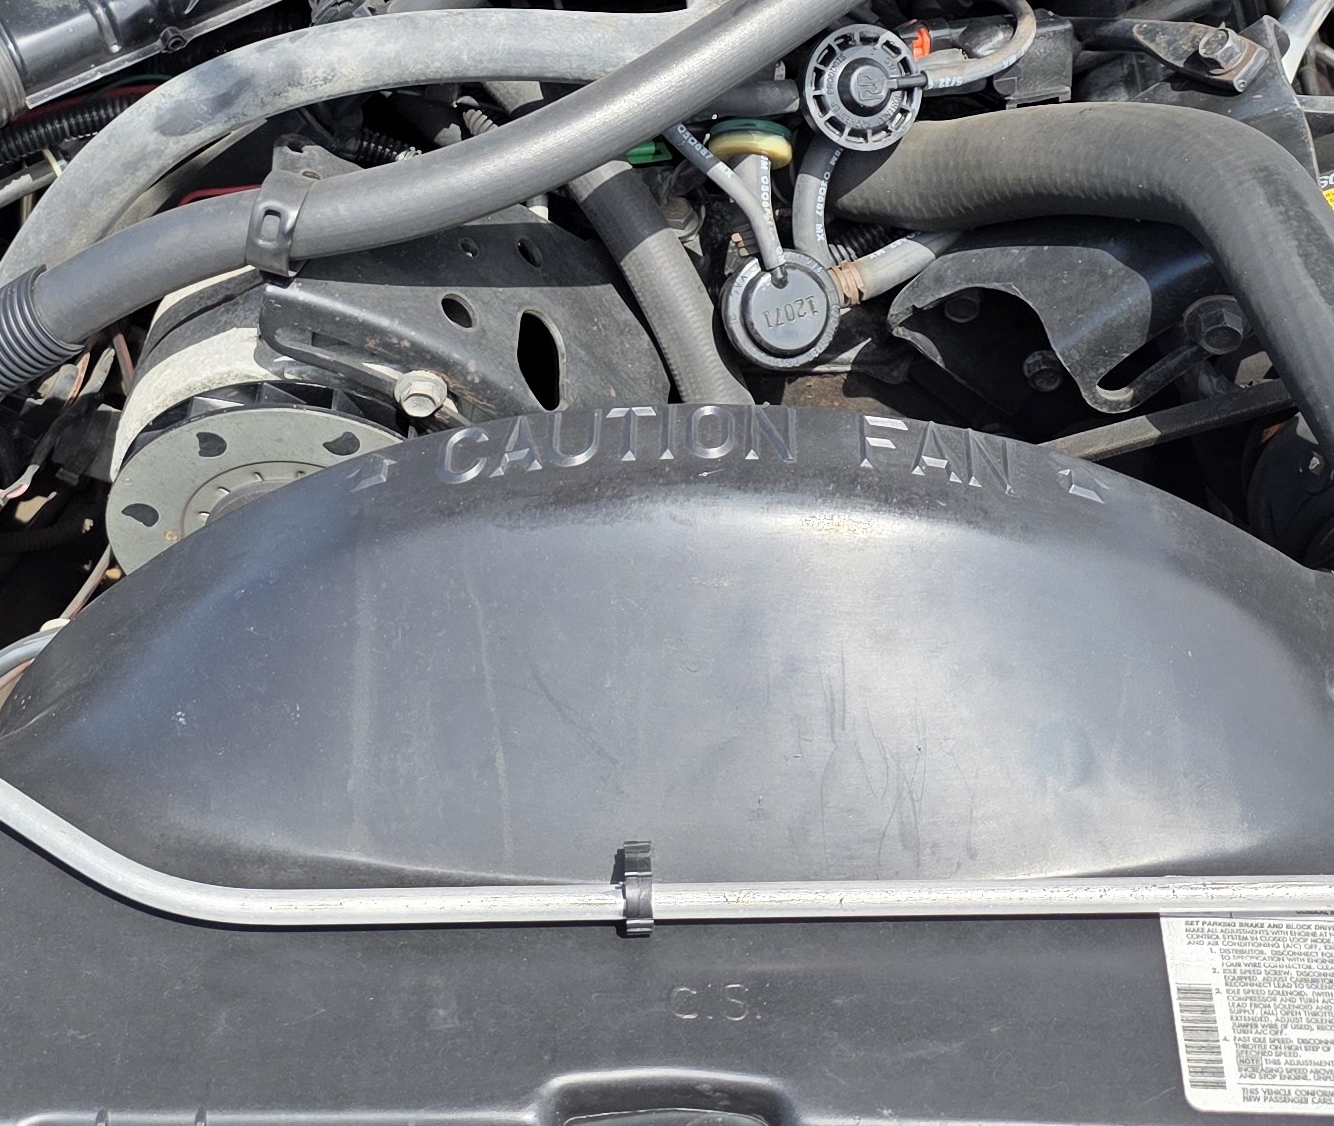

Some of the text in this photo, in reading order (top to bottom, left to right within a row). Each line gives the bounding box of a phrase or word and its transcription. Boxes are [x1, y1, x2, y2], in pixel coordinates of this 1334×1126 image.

[762, 295, 818, 328] 12071
[437, 405, 1017, 495] CAUTION FAN
